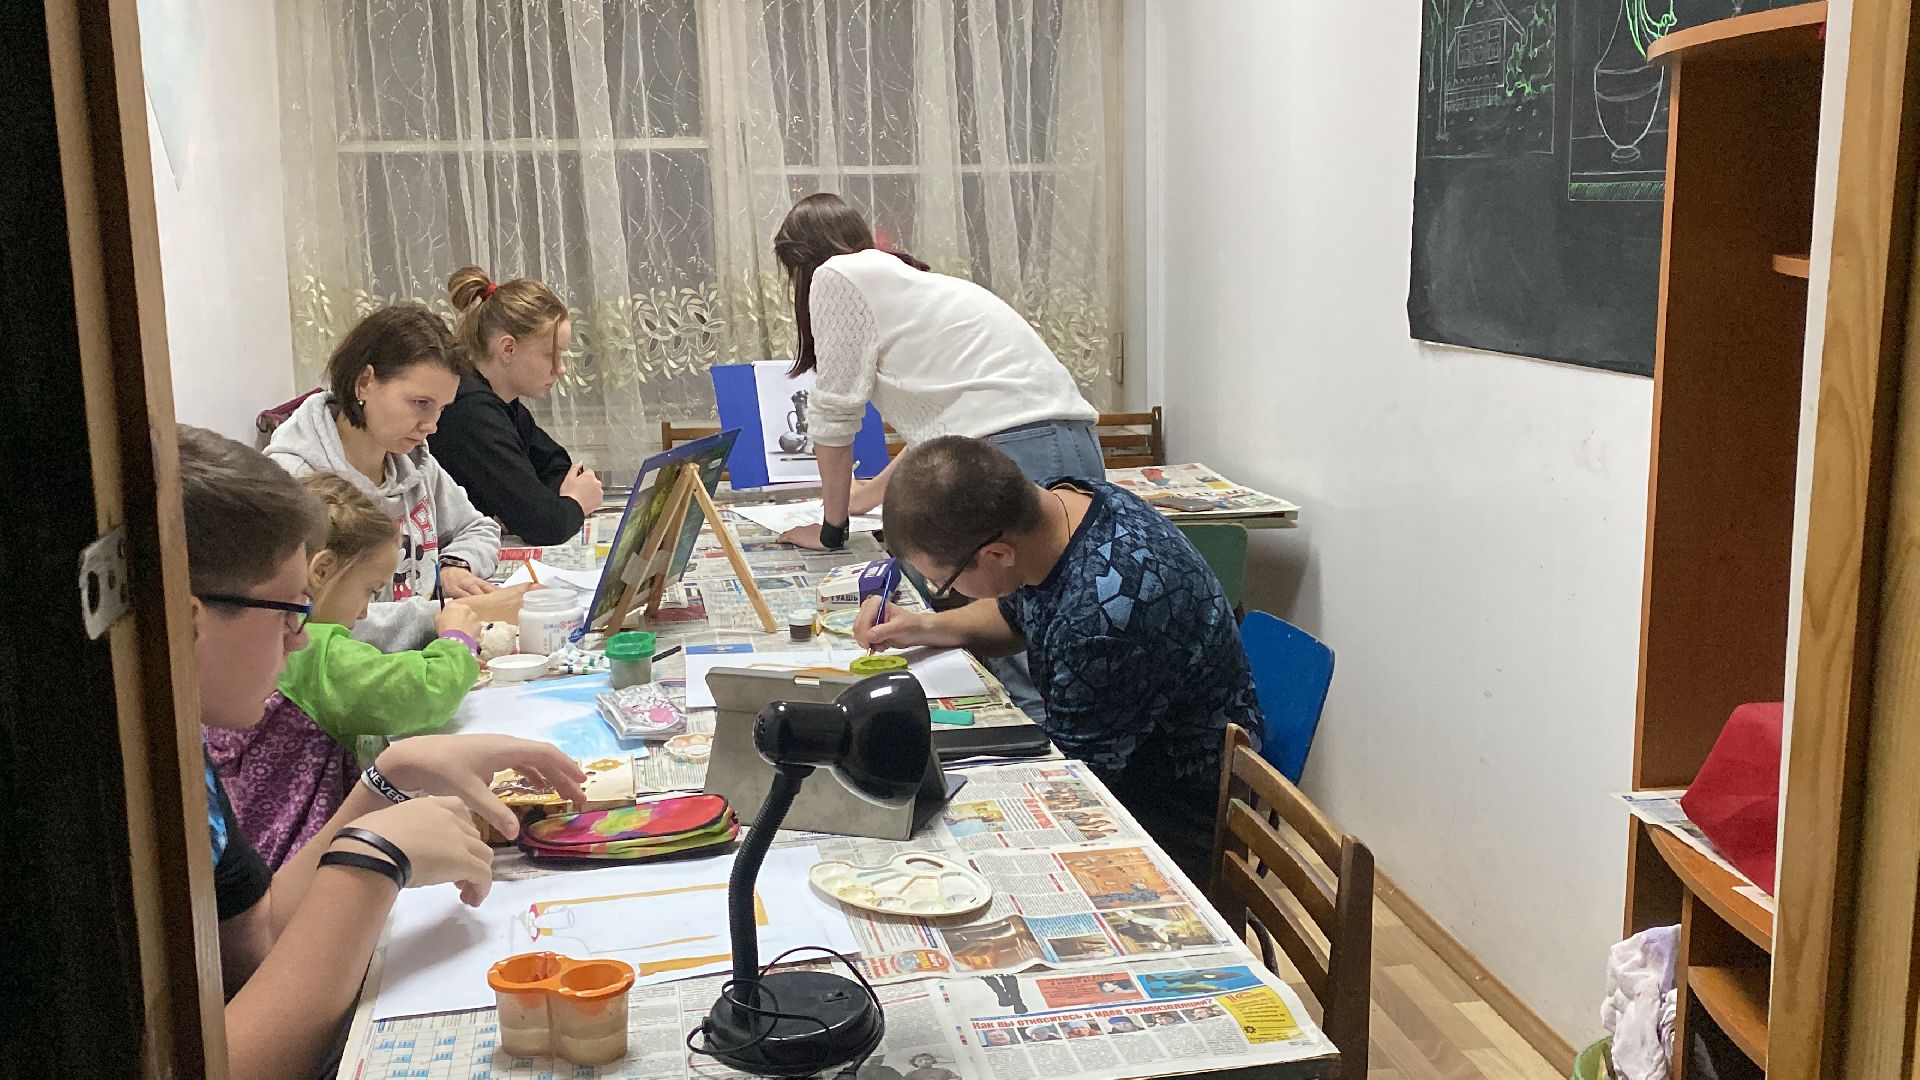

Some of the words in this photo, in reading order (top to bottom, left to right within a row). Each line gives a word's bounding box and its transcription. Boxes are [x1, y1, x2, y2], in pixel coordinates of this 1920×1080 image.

[367, 765, 405, 803] NEVER
[972, 1021, 995, 1030] Как
[997, 1019, 1015, 1028] вы
[1017, 1012, 1083, 1026] относитесь
